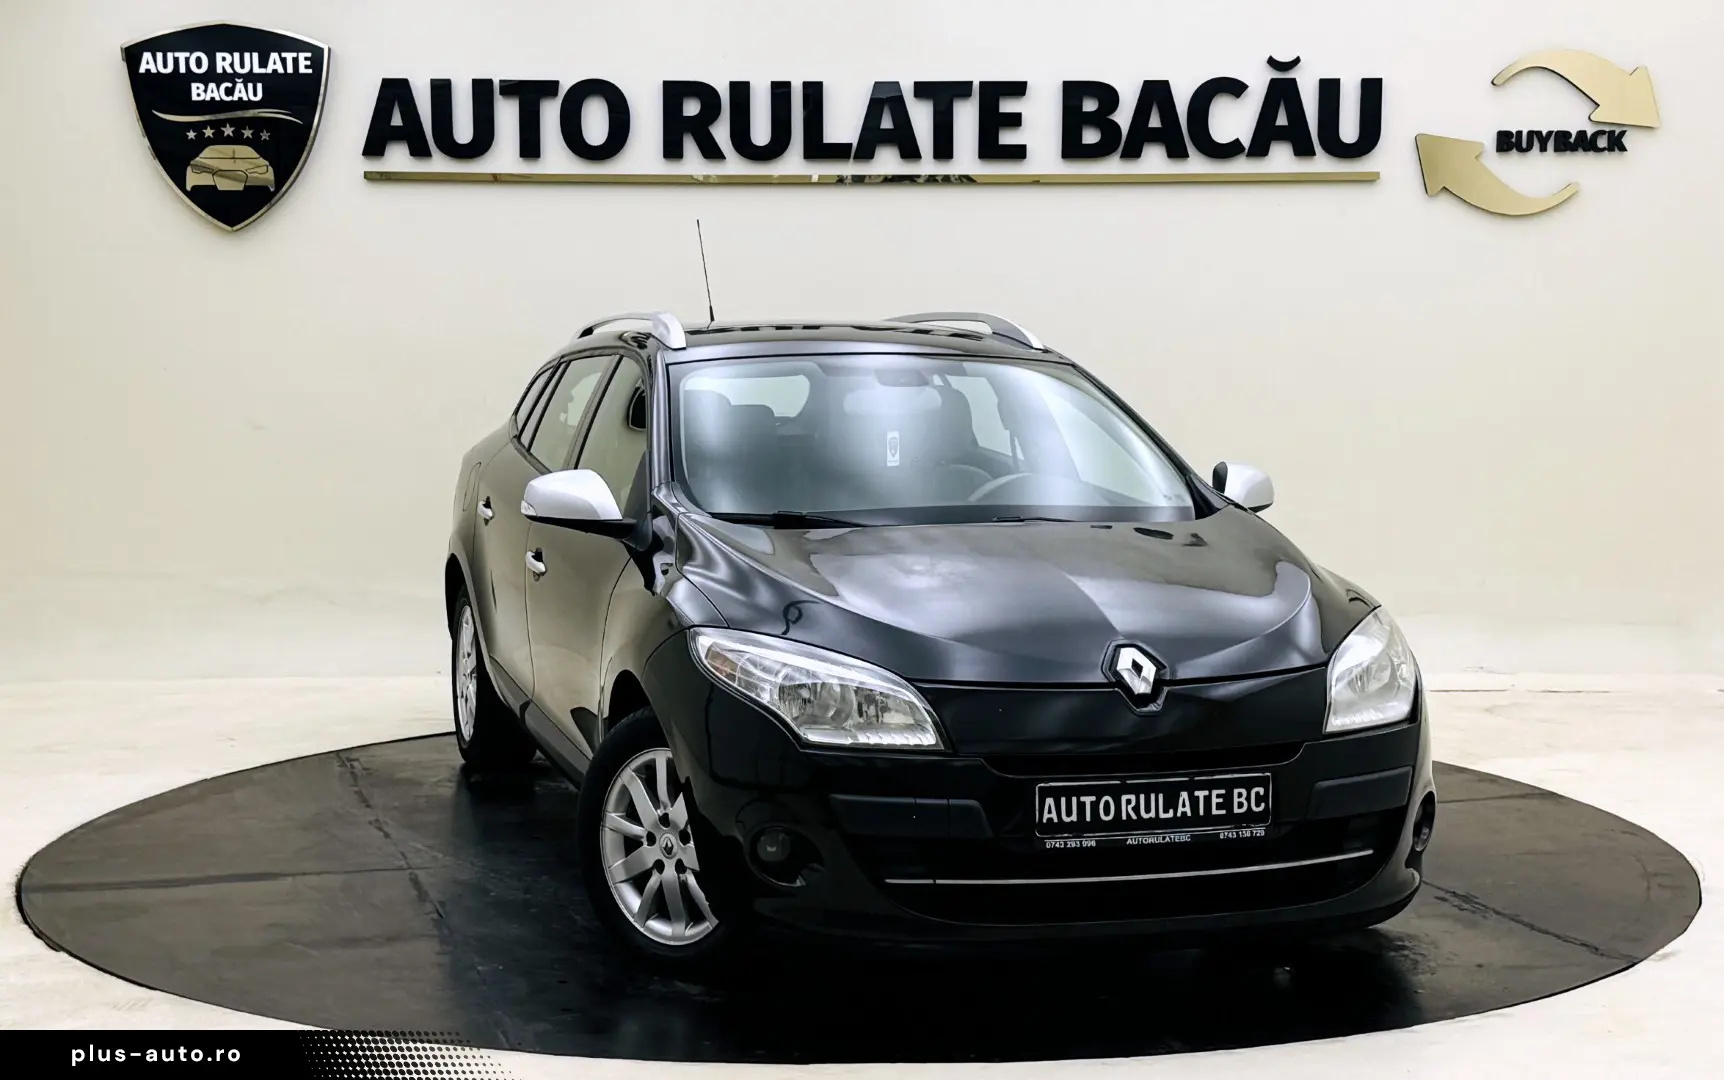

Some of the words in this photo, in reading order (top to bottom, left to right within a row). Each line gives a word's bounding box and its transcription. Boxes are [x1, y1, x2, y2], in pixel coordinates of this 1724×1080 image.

[138, 52, 209, 74] AUTO
[215, 52, 313, 74] RULATE
[190, 78, 263, 102] BACĂU
[361, 77, 631, 161] AUTO
[661, 79, 1028, 161] RULATE
[1060, 54, 1384, 160] BACĂU
[1495, 129, 1628, 153] BUYBACK
[1042, 795, 1116, 823] AUTO
[1120, 788, 1226, 821] RULATE
[1232, 786, 1266, 814] BC
